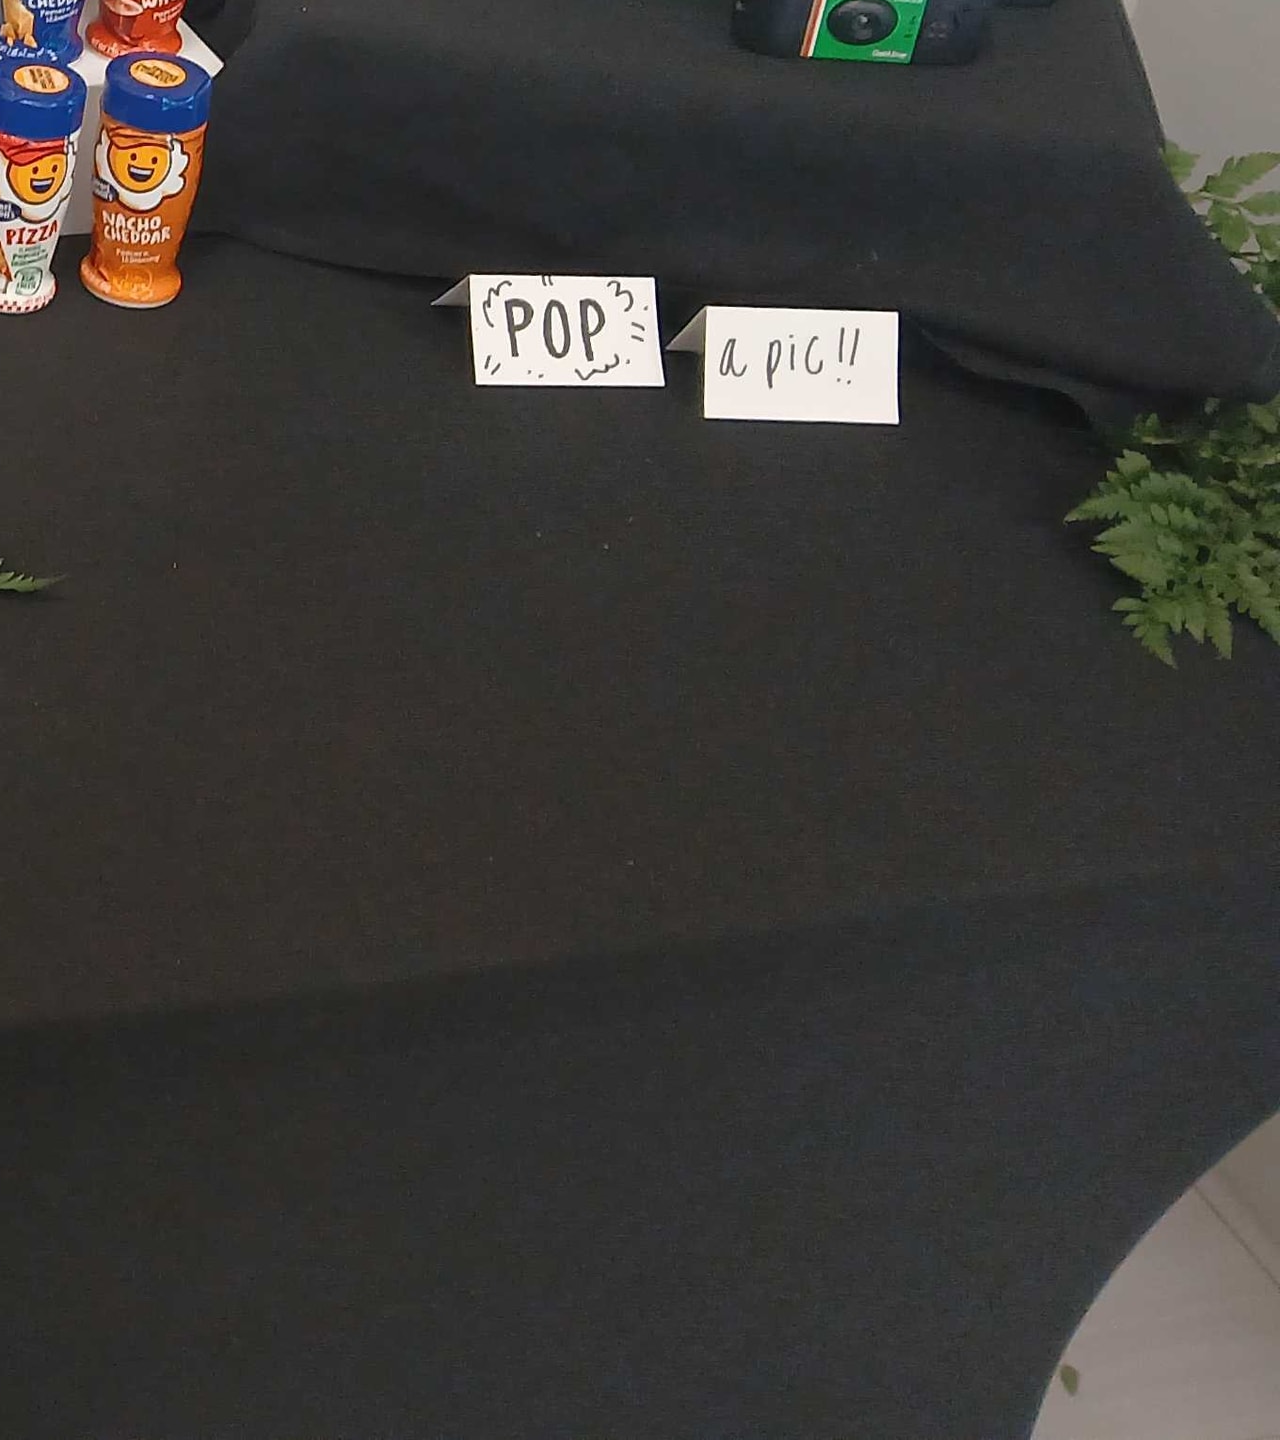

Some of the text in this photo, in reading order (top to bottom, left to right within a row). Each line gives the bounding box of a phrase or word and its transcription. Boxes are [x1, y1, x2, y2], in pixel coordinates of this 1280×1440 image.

[6, 220, 58, 245] PIZZA
[102, 210, 161, 232] NACHO
[104, 225, 171, 245] CHEDDAR
[504, 298, 606, 362] POP
[719, 338, 747, 377] a
